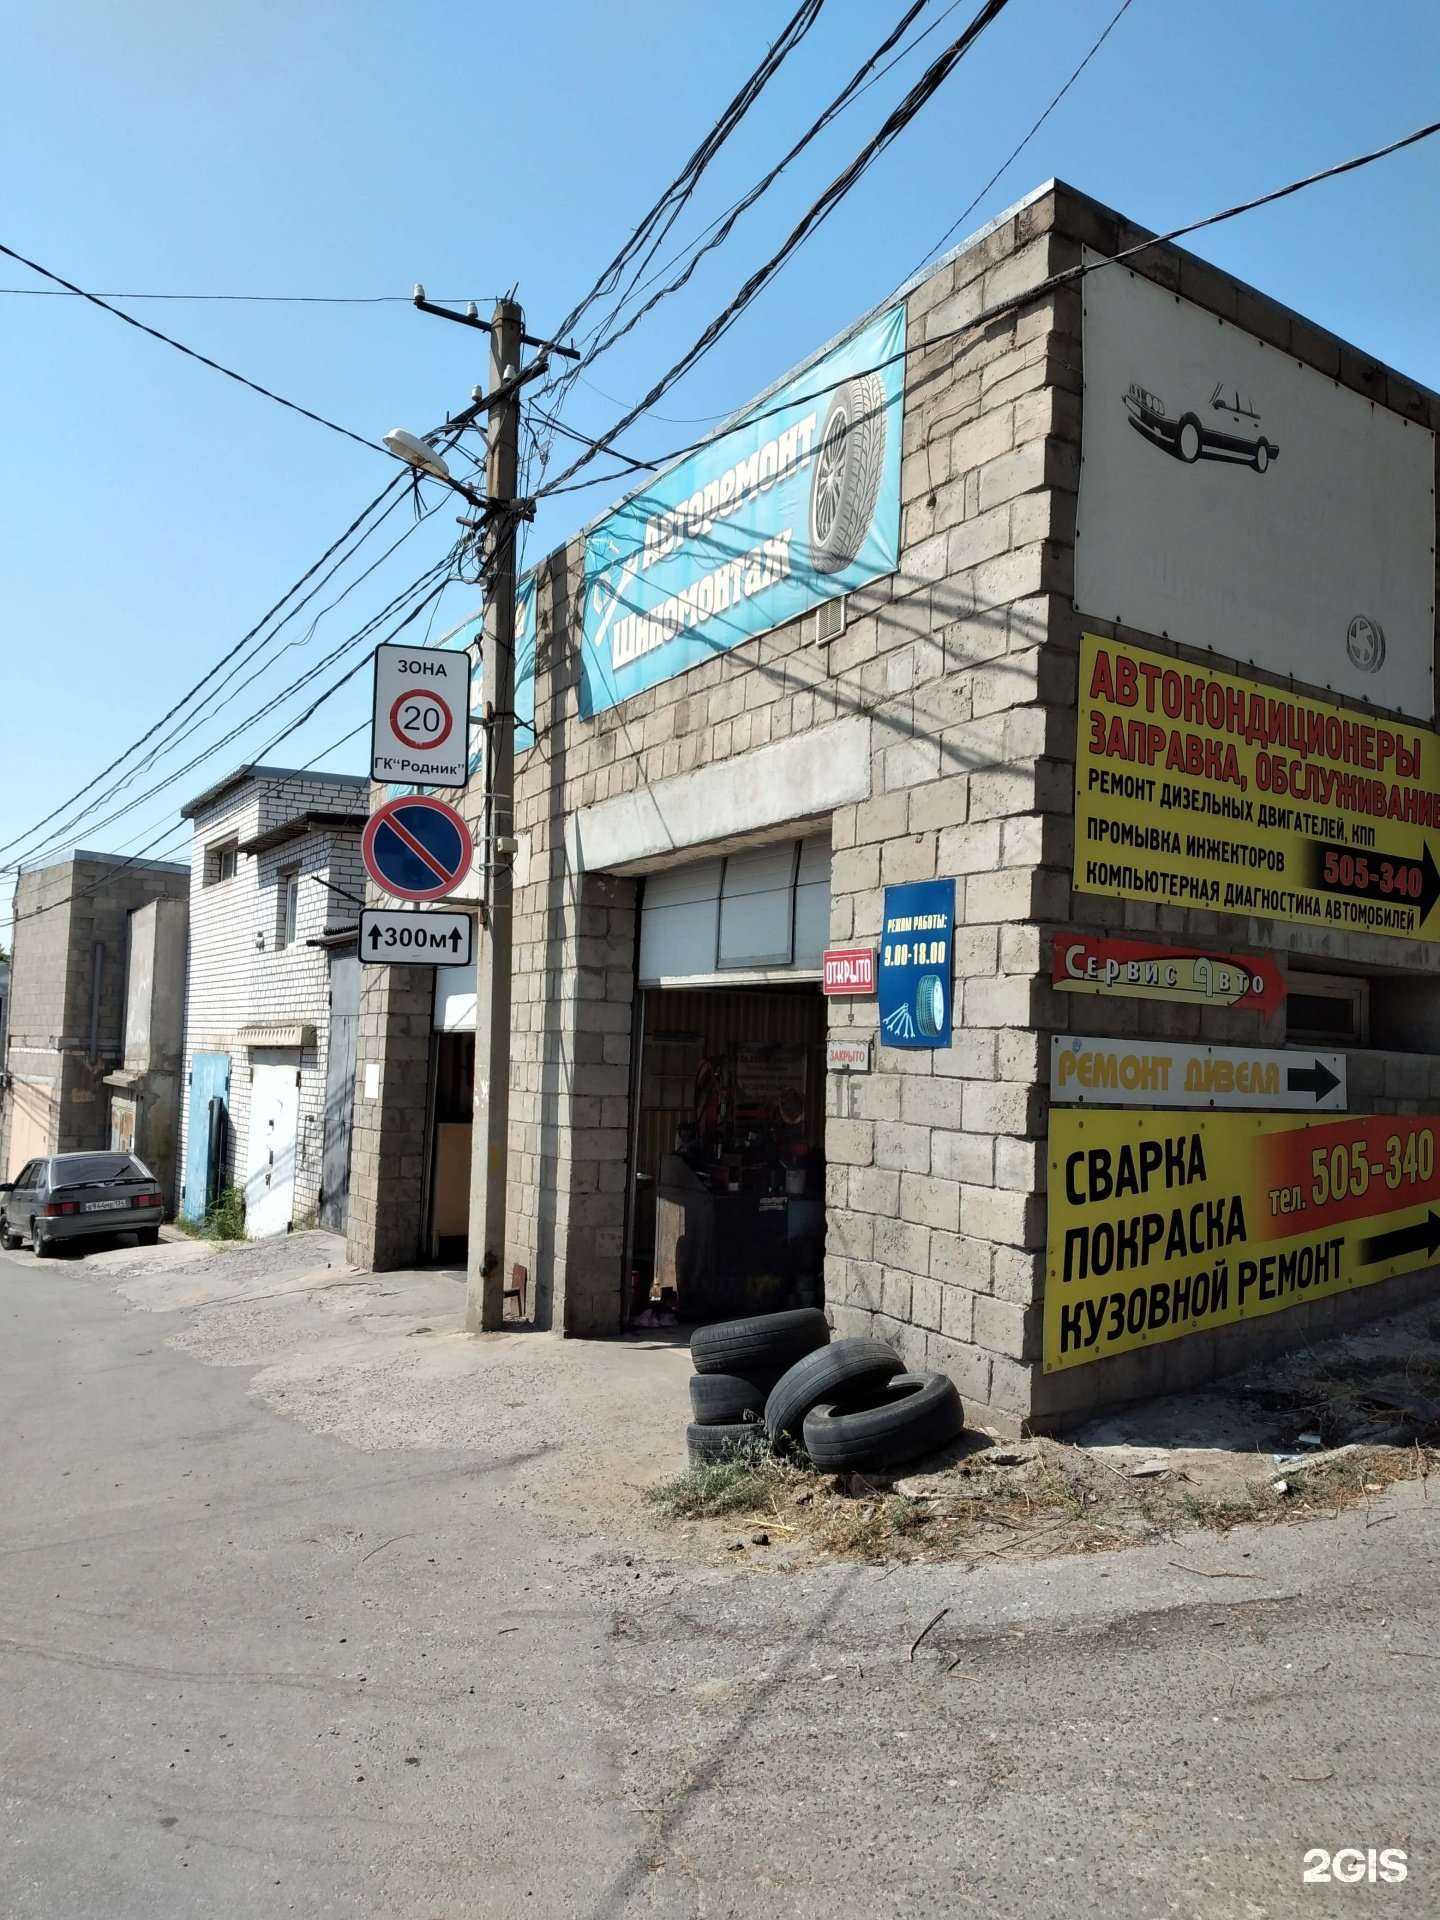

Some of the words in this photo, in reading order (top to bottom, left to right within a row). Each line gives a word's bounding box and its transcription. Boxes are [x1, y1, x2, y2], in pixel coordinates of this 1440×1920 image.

[397, 659, 448, 678] ЗОНА
[403, 705, 440, 733] 20
[1089, 650, 1421, 780] АВТОКОНДИЦИОНЕРЫ
[1088, 710, 1248, 793] ЗАПРАВКА,
[1088, 768, 1156, 802] РЕМОНТ
[1160, 783, 1254, 823] ДИЗЕЛЬНЫХ
[1257, 804, 1348, 845] ДВИГАТЕЛЕЙ,
[1352, 823, 1376, 848] КПП
[1087, 817, 1182, 857] ПРОМЫВКА
[1186, 835, 1285, 873] ИНЖЕКТОРОВ
[1086, 860, 1221, 902] КОМПЬЮТЕРНАЯ
[1224, 882, 1321, 918] ДИАГНОСТИКА
[1325, 897, 1415, 931] АВТОМОБИЛЕЙ
[1323, 851, 1423, 898] 505-340
[385, 927, 448, 949] 300м
[887, 916, 912, 934] РЕЖИМ
[913, 913, 948, 931] РАБОТЫ:
[826, 957, 872, 985] ОТКРЫТО
[884, 941, 946, 967] 9.00-18.00
[831, 1050, 865, 1063] ЗАКРЫТО
[1058, 1050, 1173, 1091] РЕМОНТ
[1065, 1133, 1207, 1206] СВАРКА
[1269, 1185, 1307, 1216] тел.
[1312, 1128, 1434, 1206] 505-340
[1062, 1195, 1247, 1283] ПОКРАСКА
[1060, 1258, 1228, 1354] КУЗОВНОЙ
[1238, 1237, 1346, 1307] РЕМОНТ
